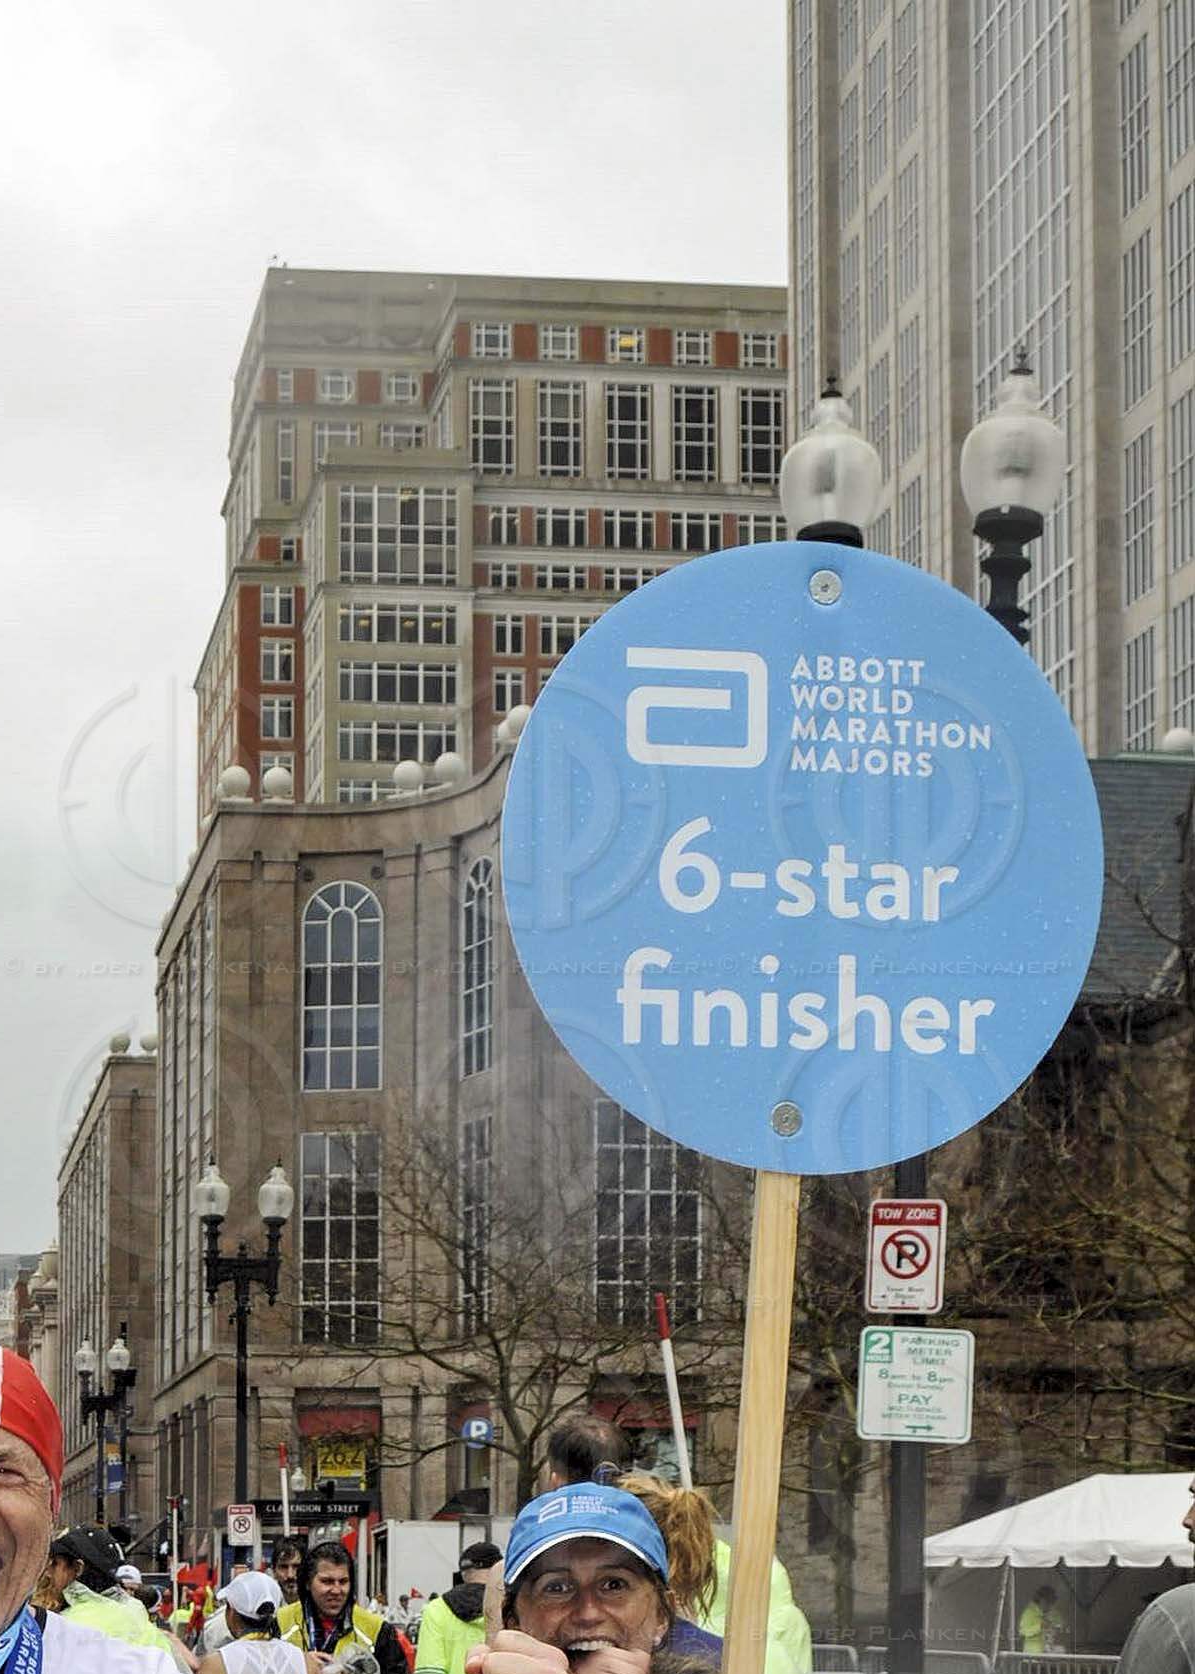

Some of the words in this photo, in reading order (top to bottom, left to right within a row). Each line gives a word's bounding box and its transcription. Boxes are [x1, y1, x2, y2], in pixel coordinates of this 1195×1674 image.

[790, 654, 924, 686] ABBOTT
[790, 684, 914, 714] WORLD
[790, 716, 993, 750] MARATHON
[790, 747, 934, 777] MAJORS
[658, 815, 960, 922] 6-star
[616, 946, 996, 1055] finisher
[877, 1207, 903, 1219] TOW
[905, 1207, 938, 1219] ZONE
[868, 1332, 891, 1354] 2
[898, 1393, 933, 1405] PAY
[266, 1504, 321, 1513] CLAENDON
[327, 1504, 359, 1513] STREET
